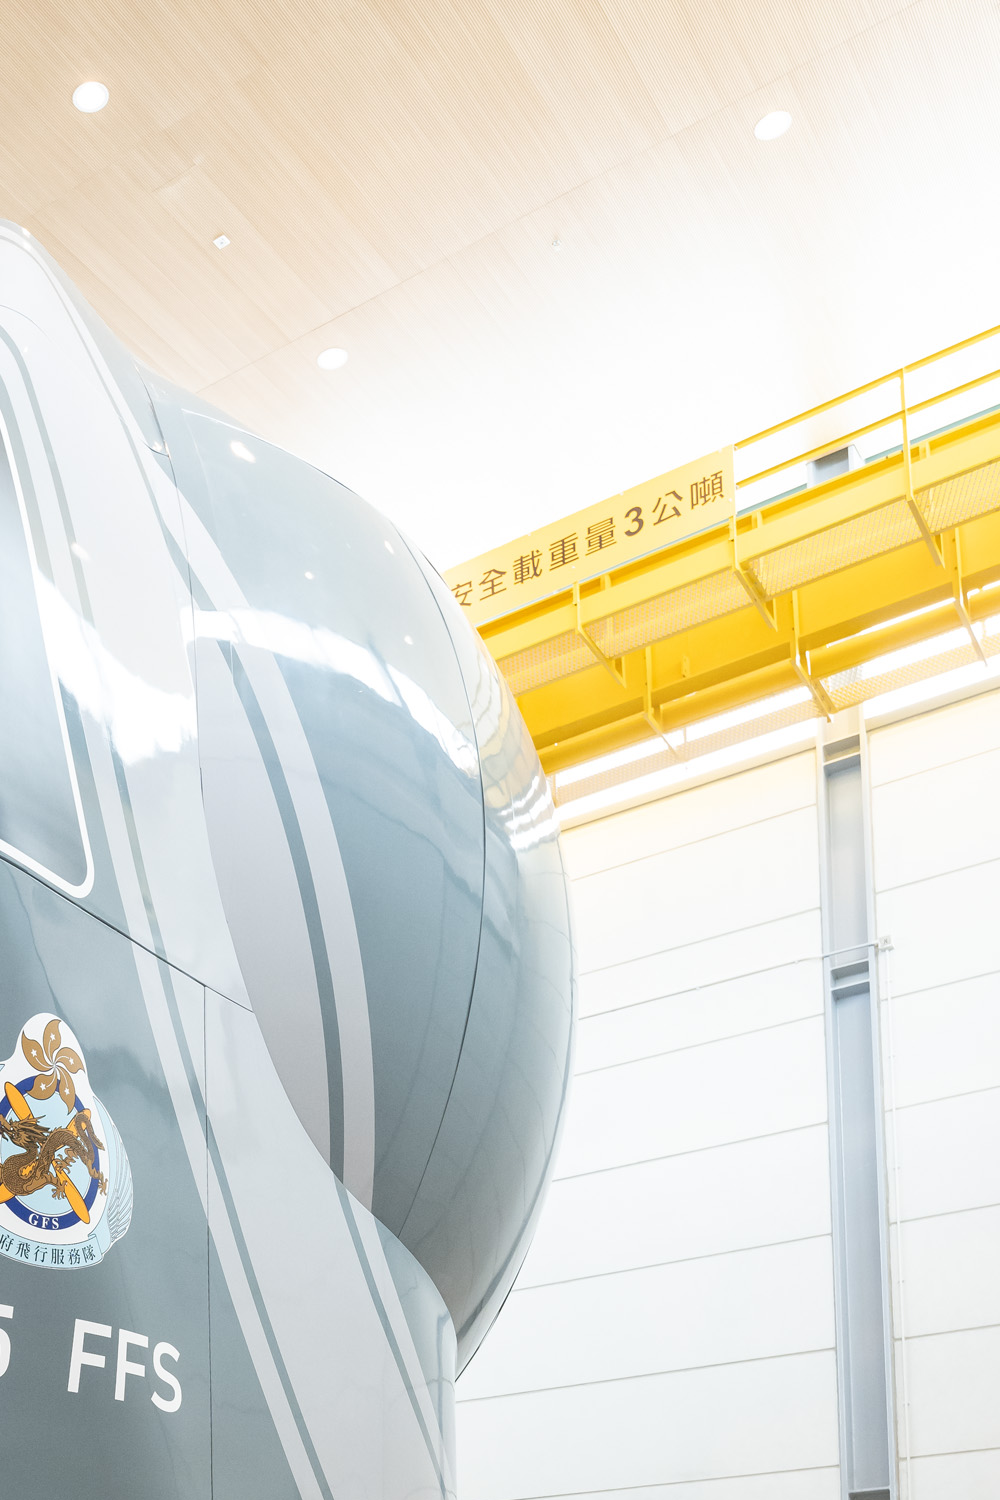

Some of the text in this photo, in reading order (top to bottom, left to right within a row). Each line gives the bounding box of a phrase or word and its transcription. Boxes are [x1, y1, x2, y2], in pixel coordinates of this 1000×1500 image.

[451, 470, 725, 607] 安全載重量3公噸
[28, 1213, 60, 1230] GFS
[67, 1318, 183, 1413] FFS
